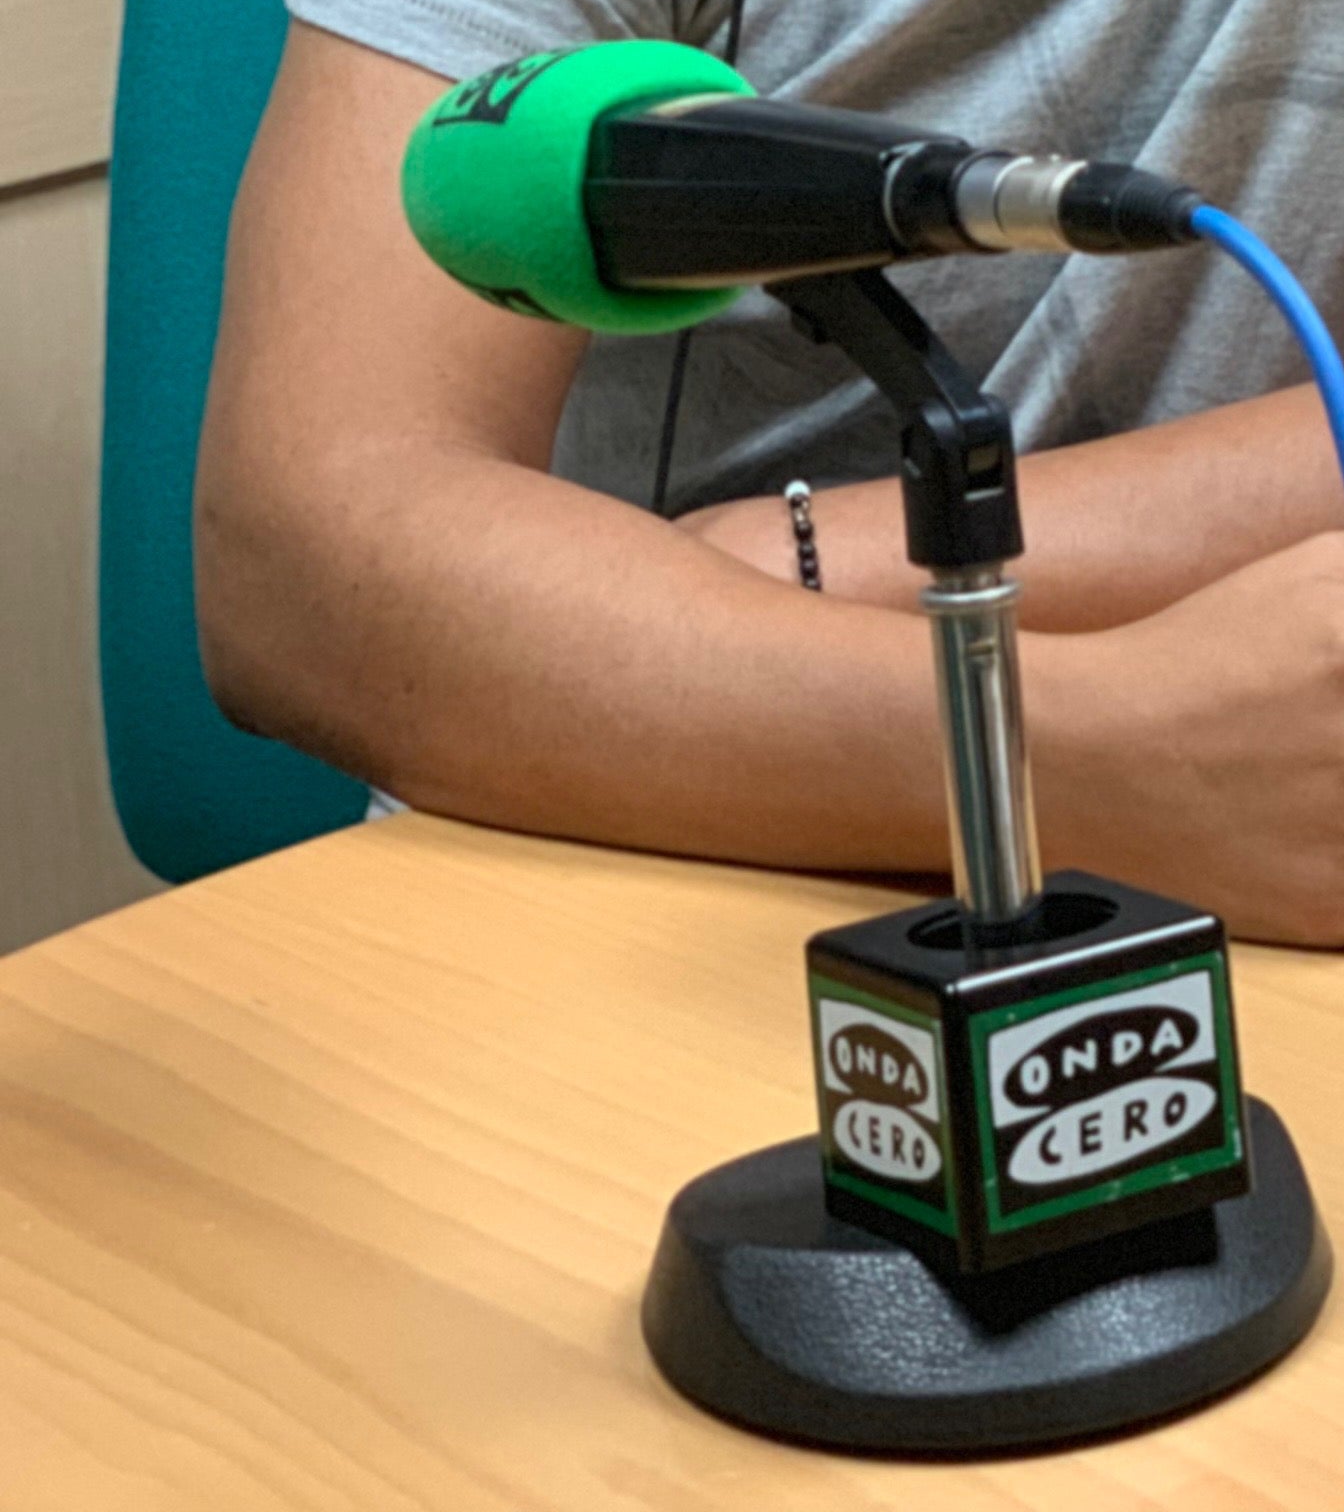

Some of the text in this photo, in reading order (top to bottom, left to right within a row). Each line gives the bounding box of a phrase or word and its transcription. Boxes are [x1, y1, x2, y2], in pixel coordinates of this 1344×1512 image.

[834, 1036, 922, 1095] ONDA
[1018, 1018, 1185, 1095] ONDA
[847, 1109, 927, 1172] CERO
[1037, 1090, 1189, 1166] CERO
